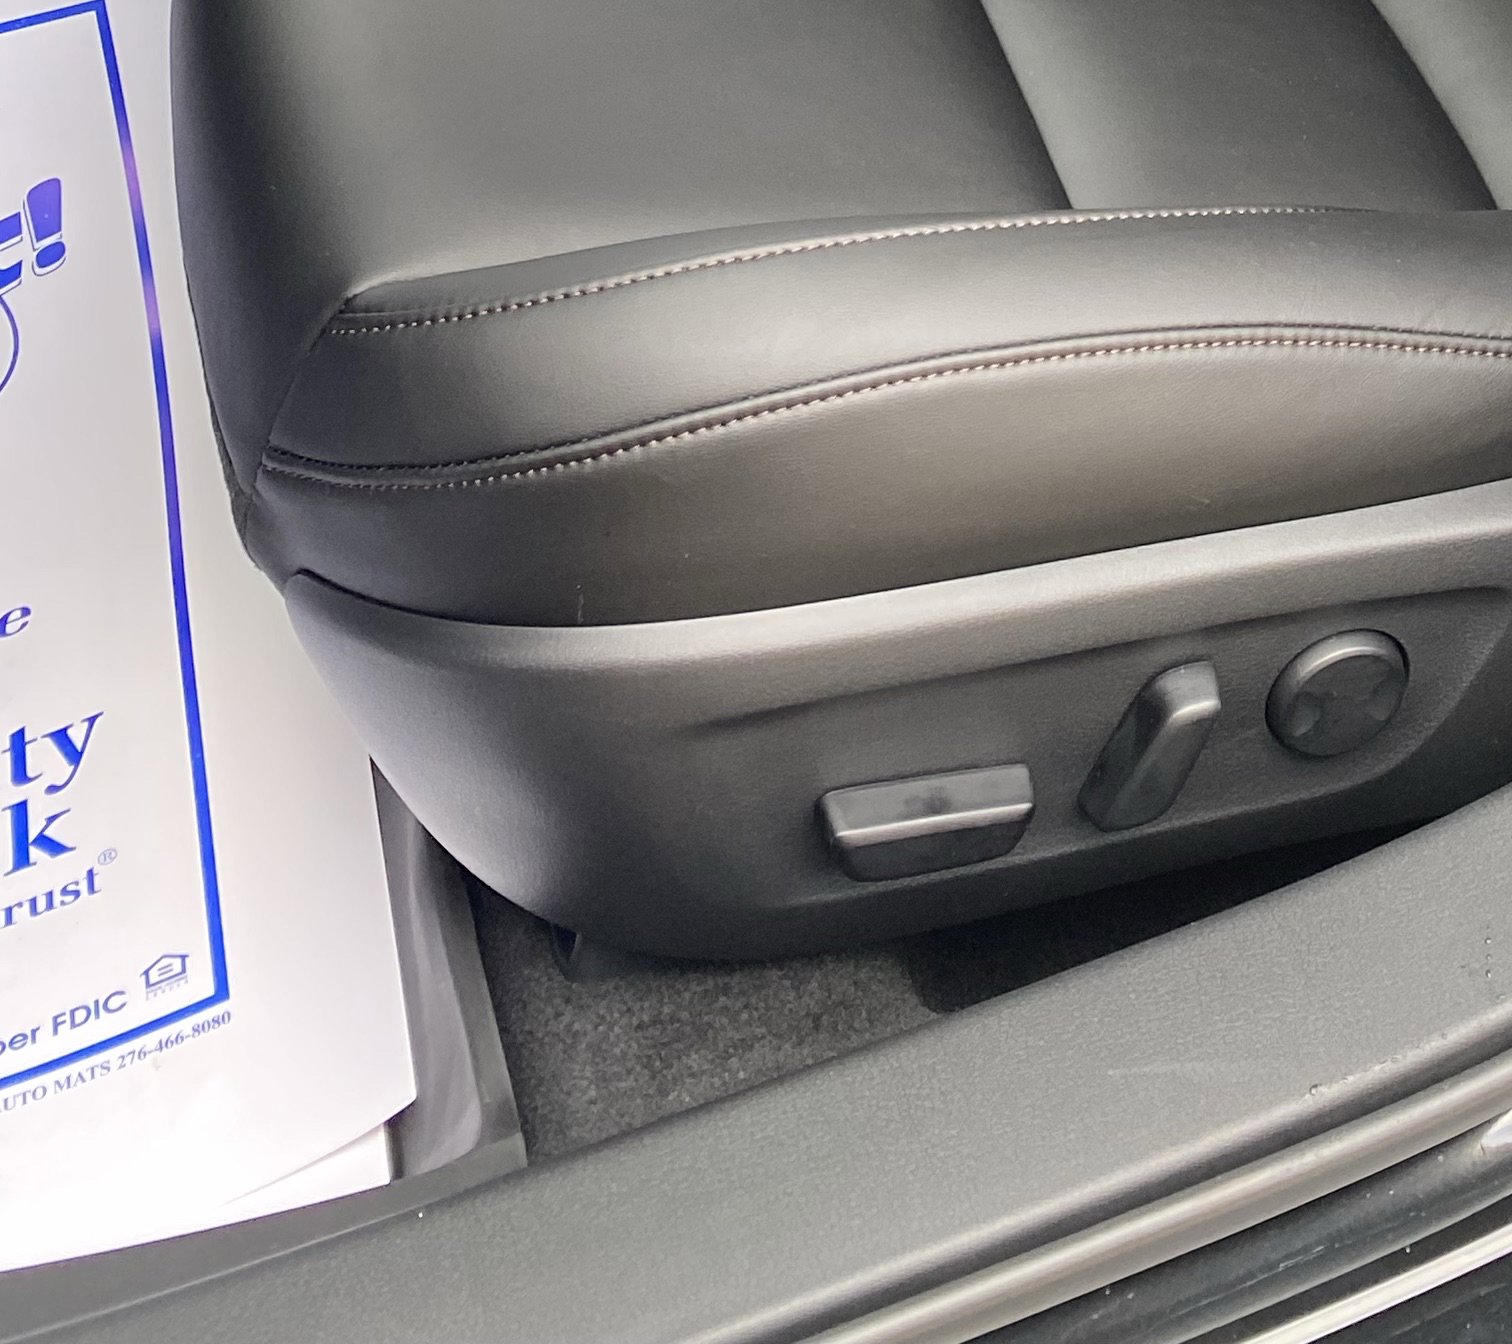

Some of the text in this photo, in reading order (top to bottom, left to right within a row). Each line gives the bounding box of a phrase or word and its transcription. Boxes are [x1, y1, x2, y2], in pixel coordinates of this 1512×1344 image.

[1, 712, 104, 795] ty
[2, 799, 76, 876] k
[52, 990, 128, 1036] FDIC
[53, 1060, 111, 1095] MATS
[117, 1010, 232, 1070] 276-466-8080
